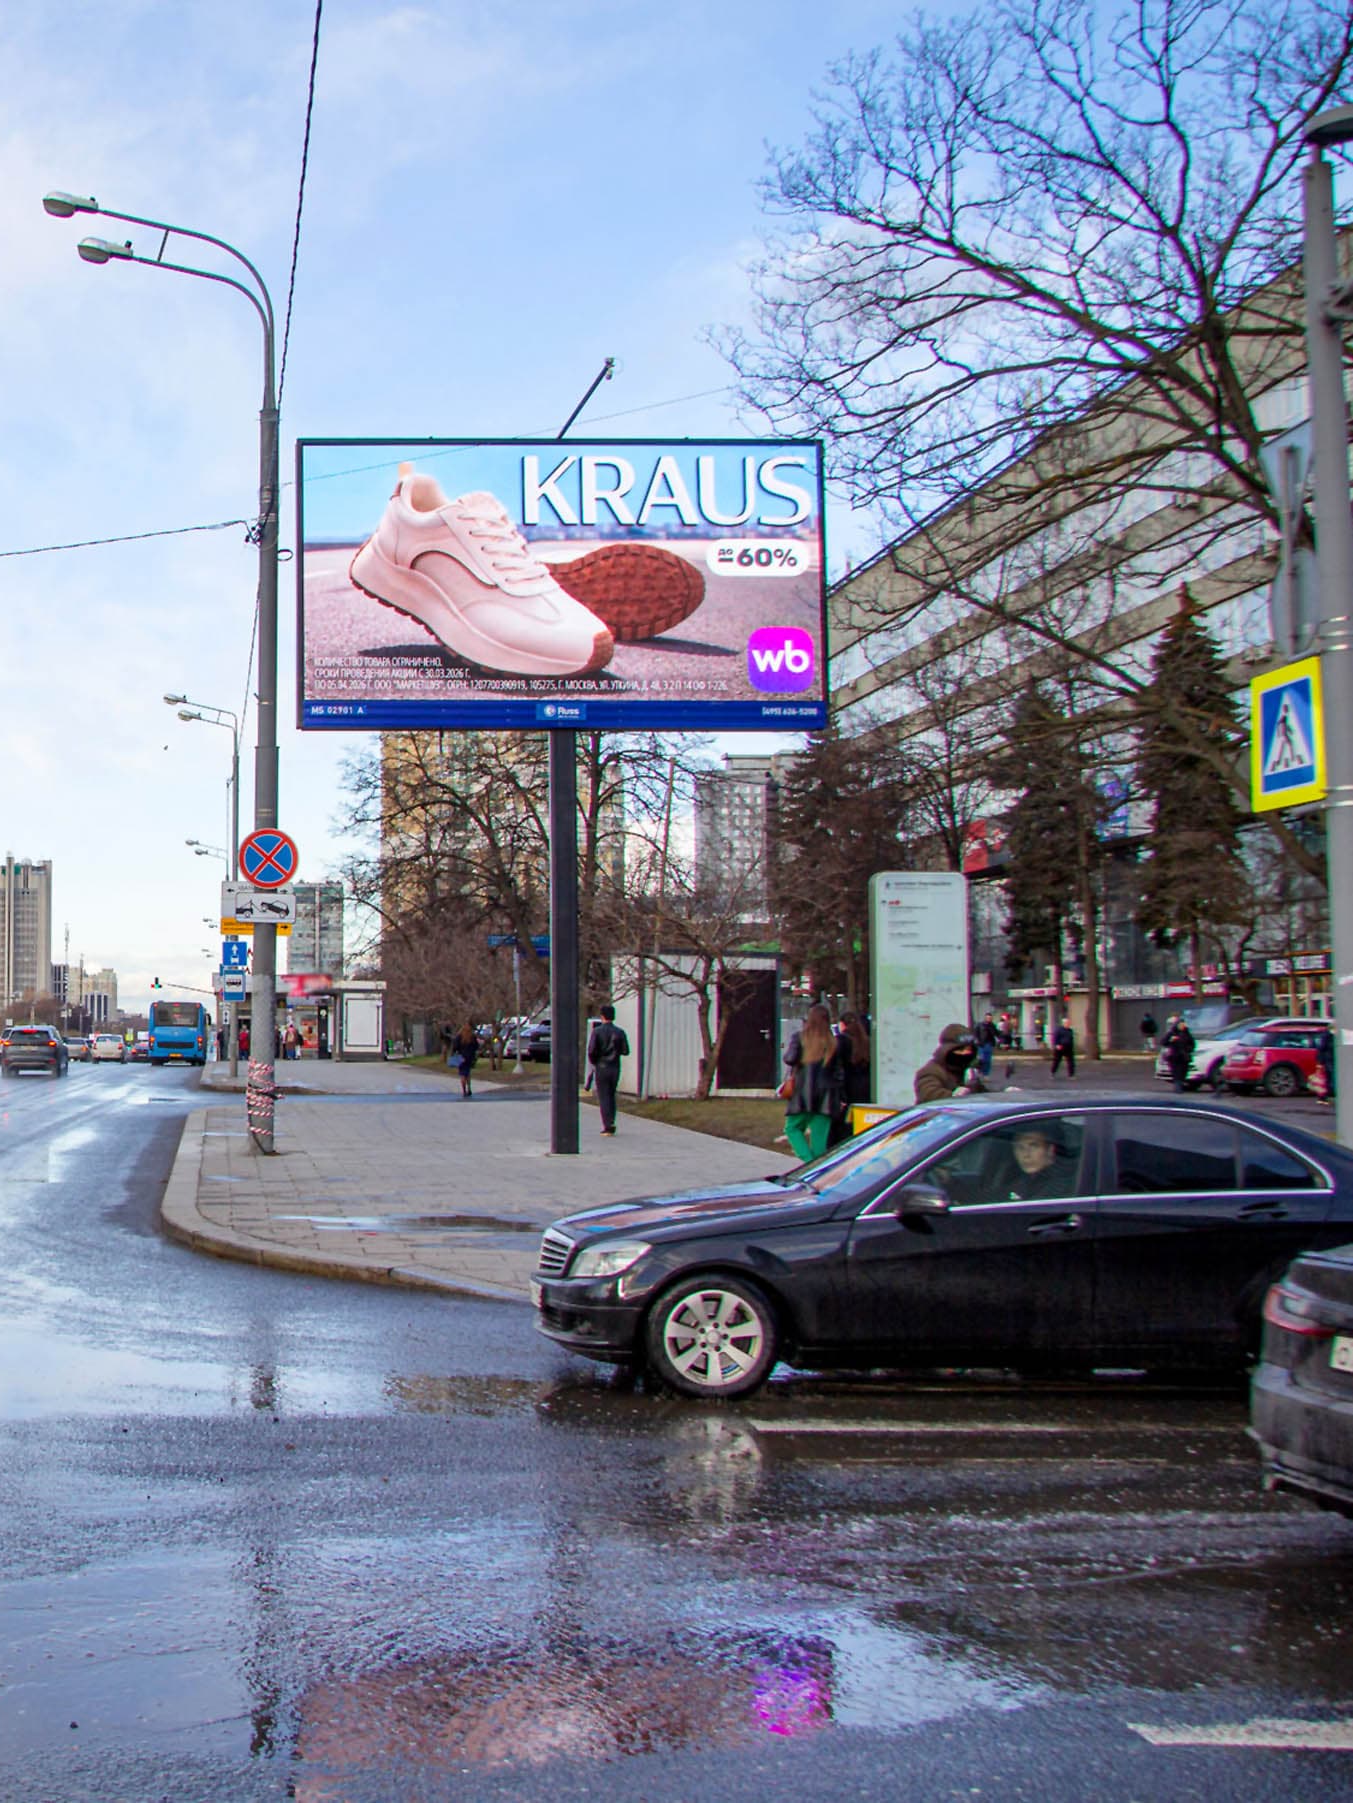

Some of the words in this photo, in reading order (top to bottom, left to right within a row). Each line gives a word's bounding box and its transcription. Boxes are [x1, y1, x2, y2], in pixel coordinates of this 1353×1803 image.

[521, 455, 812, 527] KRAUS
[314, 656, 364, 667] КОЛИЧЕСТВО
[364, 656, 391, 667] ТОВАРА
[392, 656, 442, 667] ОГРАНИЧЕНО.
[751, 640, 810, 673] wb
[314, 668, 339, 679] СРОКИ
[341, 668, 390, 679] ПРОВЕДЕНИЯ
[391, 668, 417, 679] АКЦИИ
[418, 668, 424, 679] С
[425, 668, 464, 679] 30.03.2026
[314, 680, 326, 690] ПО
[327, 680, 366, 690] 05.04.2026
